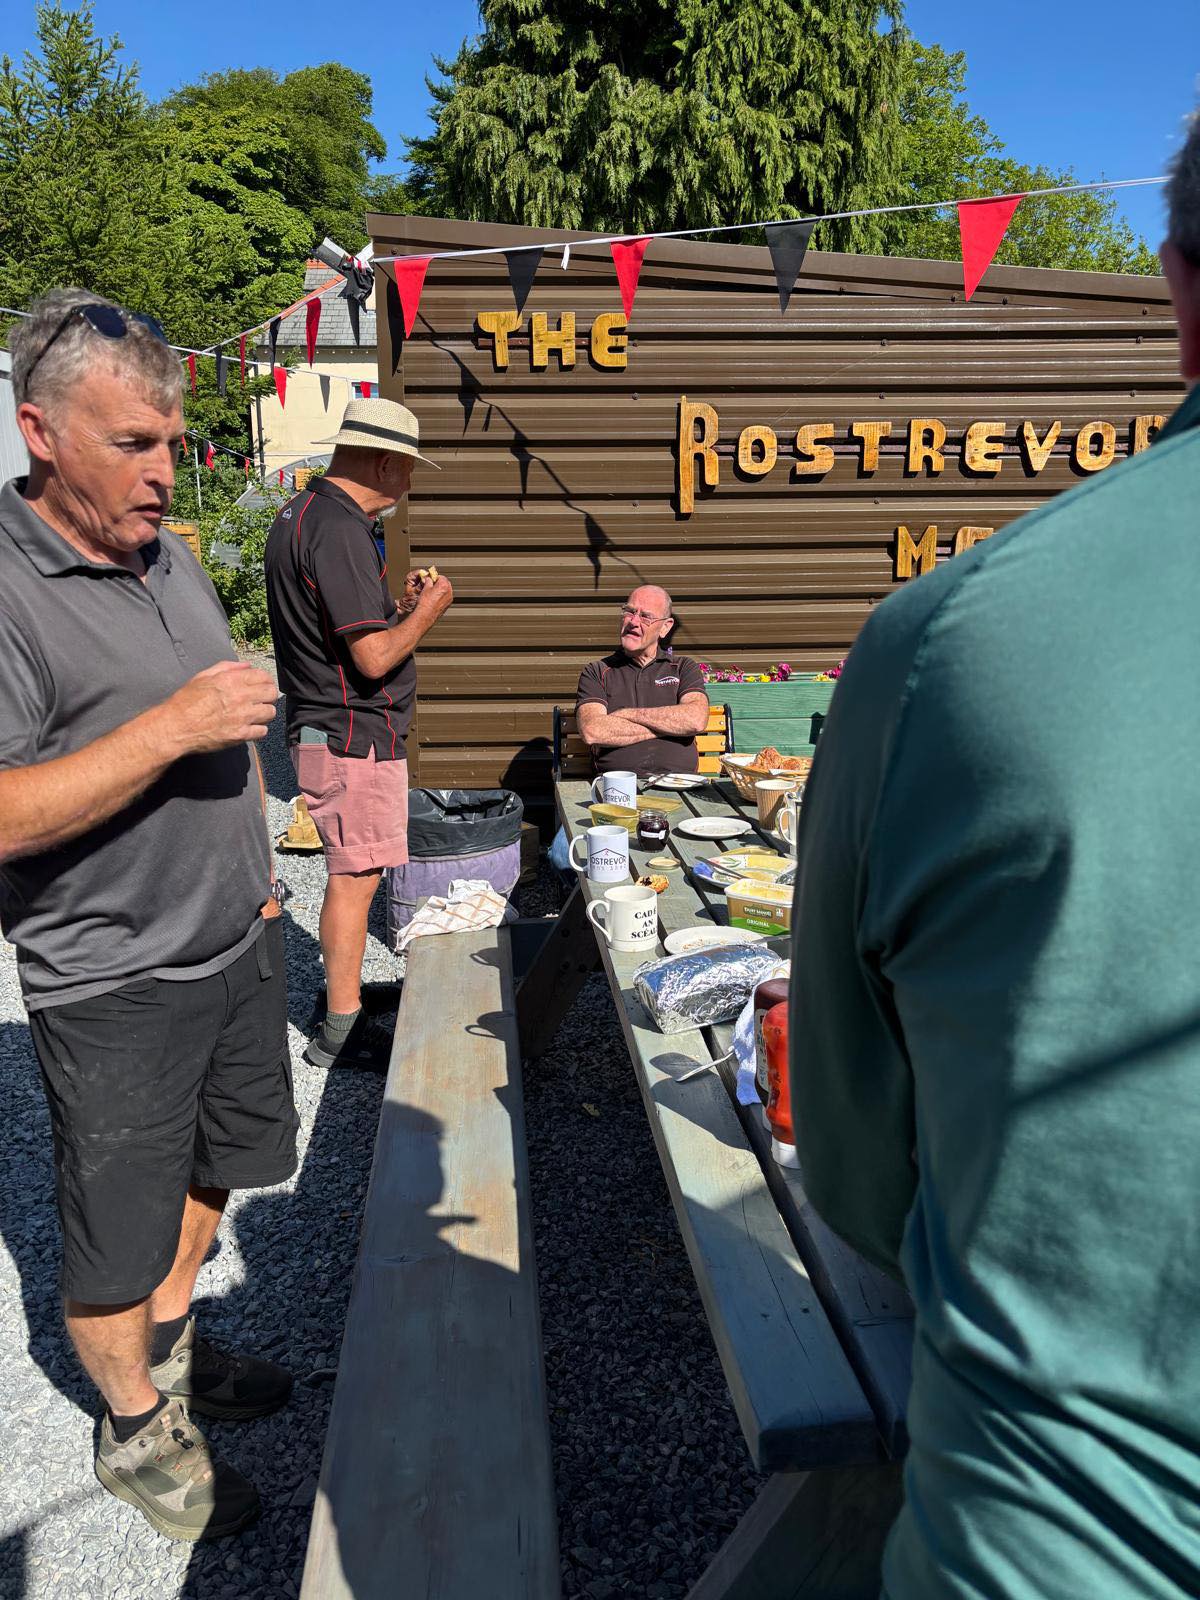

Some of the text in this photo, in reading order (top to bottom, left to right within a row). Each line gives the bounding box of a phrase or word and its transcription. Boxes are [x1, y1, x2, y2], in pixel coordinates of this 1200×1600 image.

[477, 311, 629, 367] THE
[603, 793, 631, 803] STREVOR
[590, 855, 627, 866] OSTREVOR
[642, 918, 654, 928] AN
[746, 918, 770, 927] ORIGINAL
